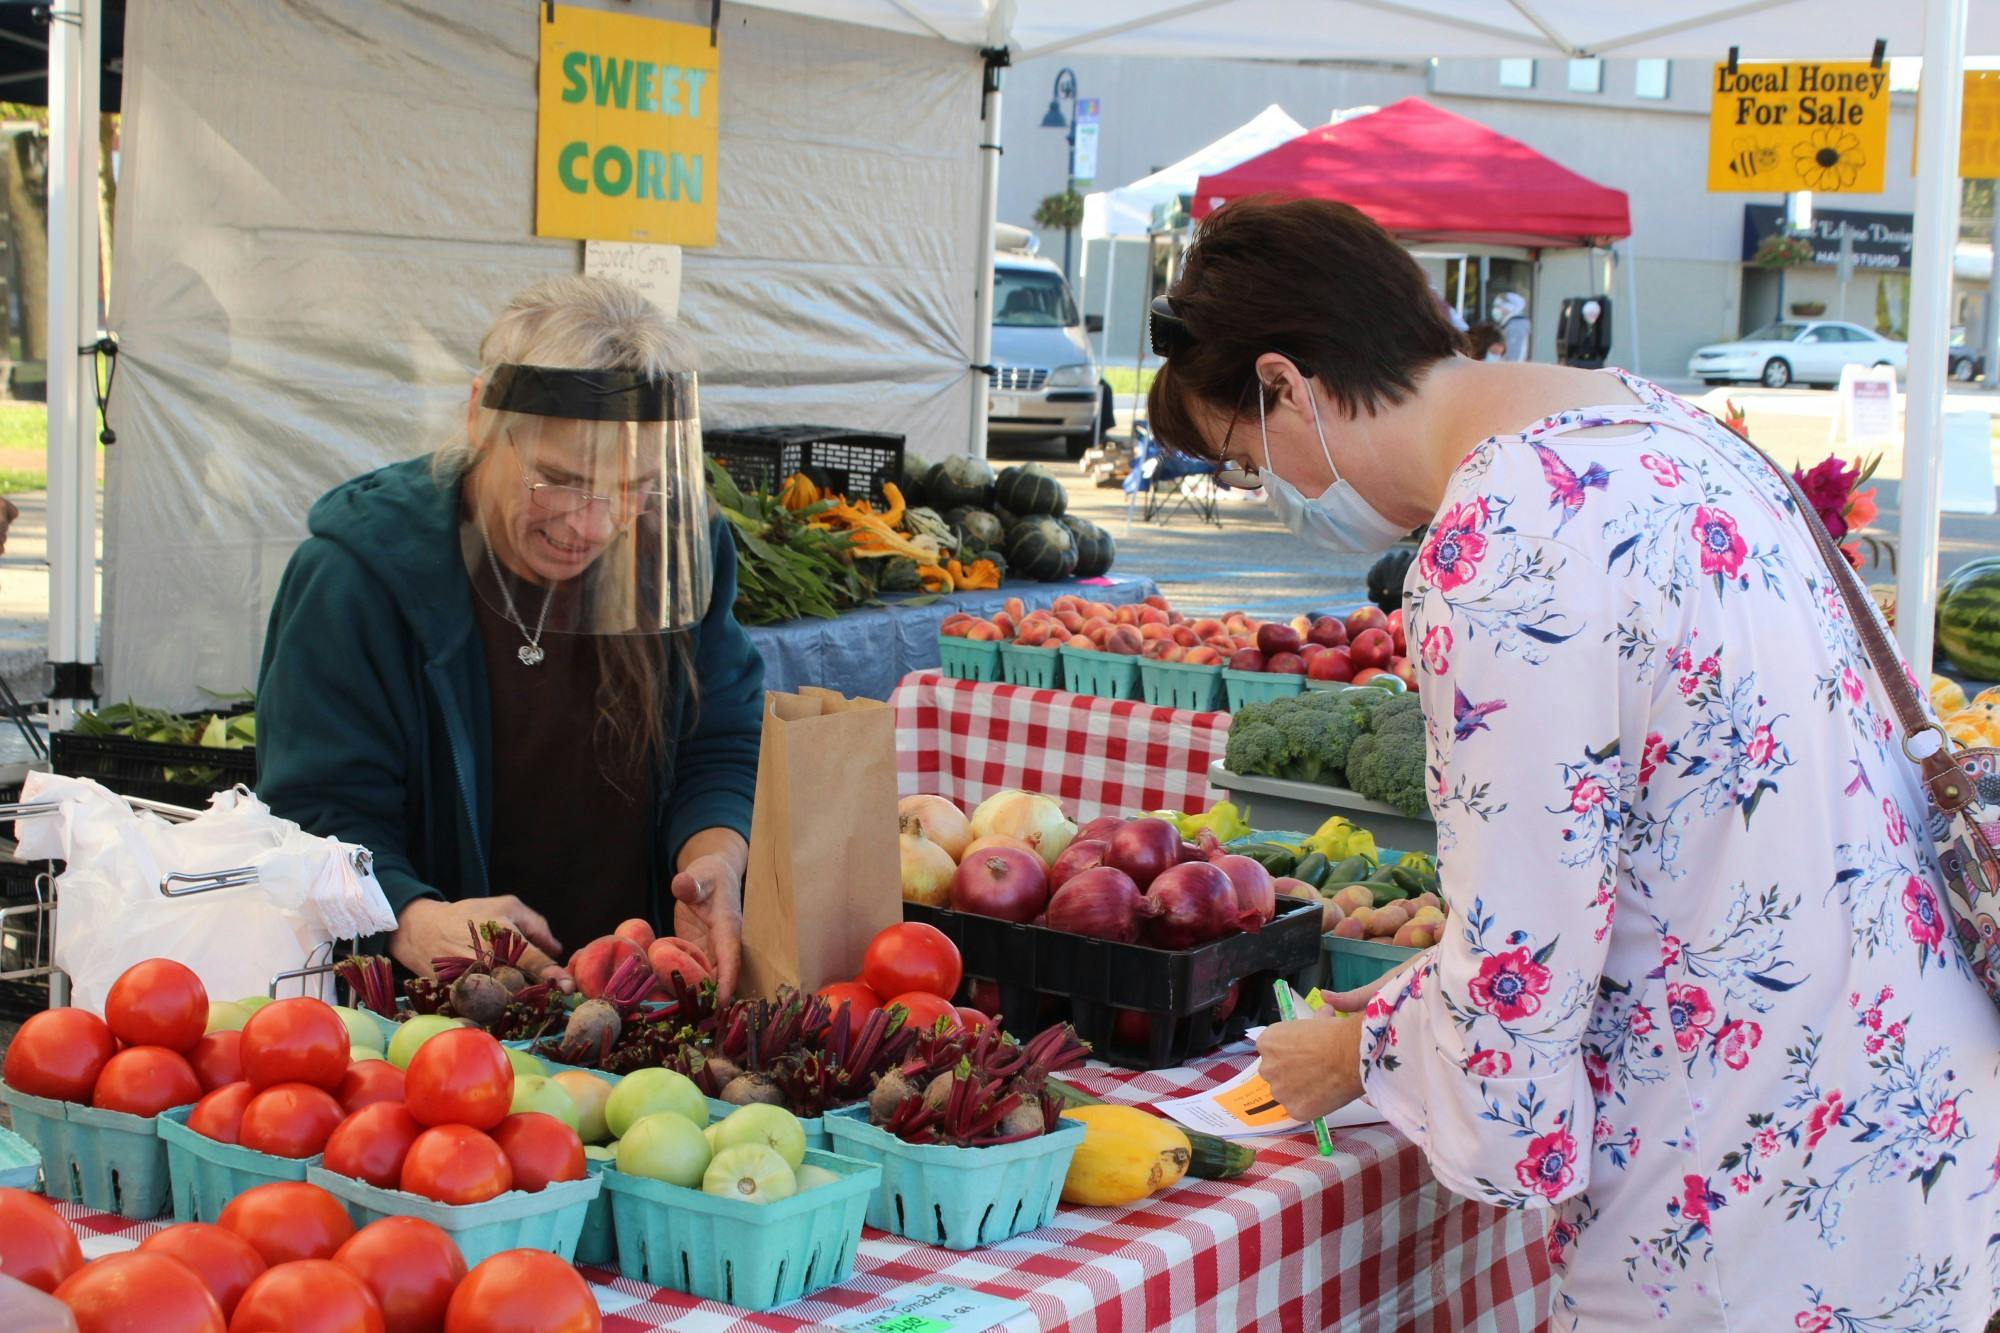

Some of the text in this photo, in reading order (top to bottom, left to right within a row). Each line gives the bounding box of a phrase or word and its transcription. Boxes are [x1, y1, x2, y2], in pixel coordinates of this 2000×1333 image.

[562, 51, 706, 118] SWEET
[1717, 65, 1886, 100] Local Honey
[1735, 96, 1863, 125] For Sale
[558, 140, 703, 204] CORN
[1868, 223, 1914, 252] Desig
[882, 1285, 956, 1315] Tomatoes
